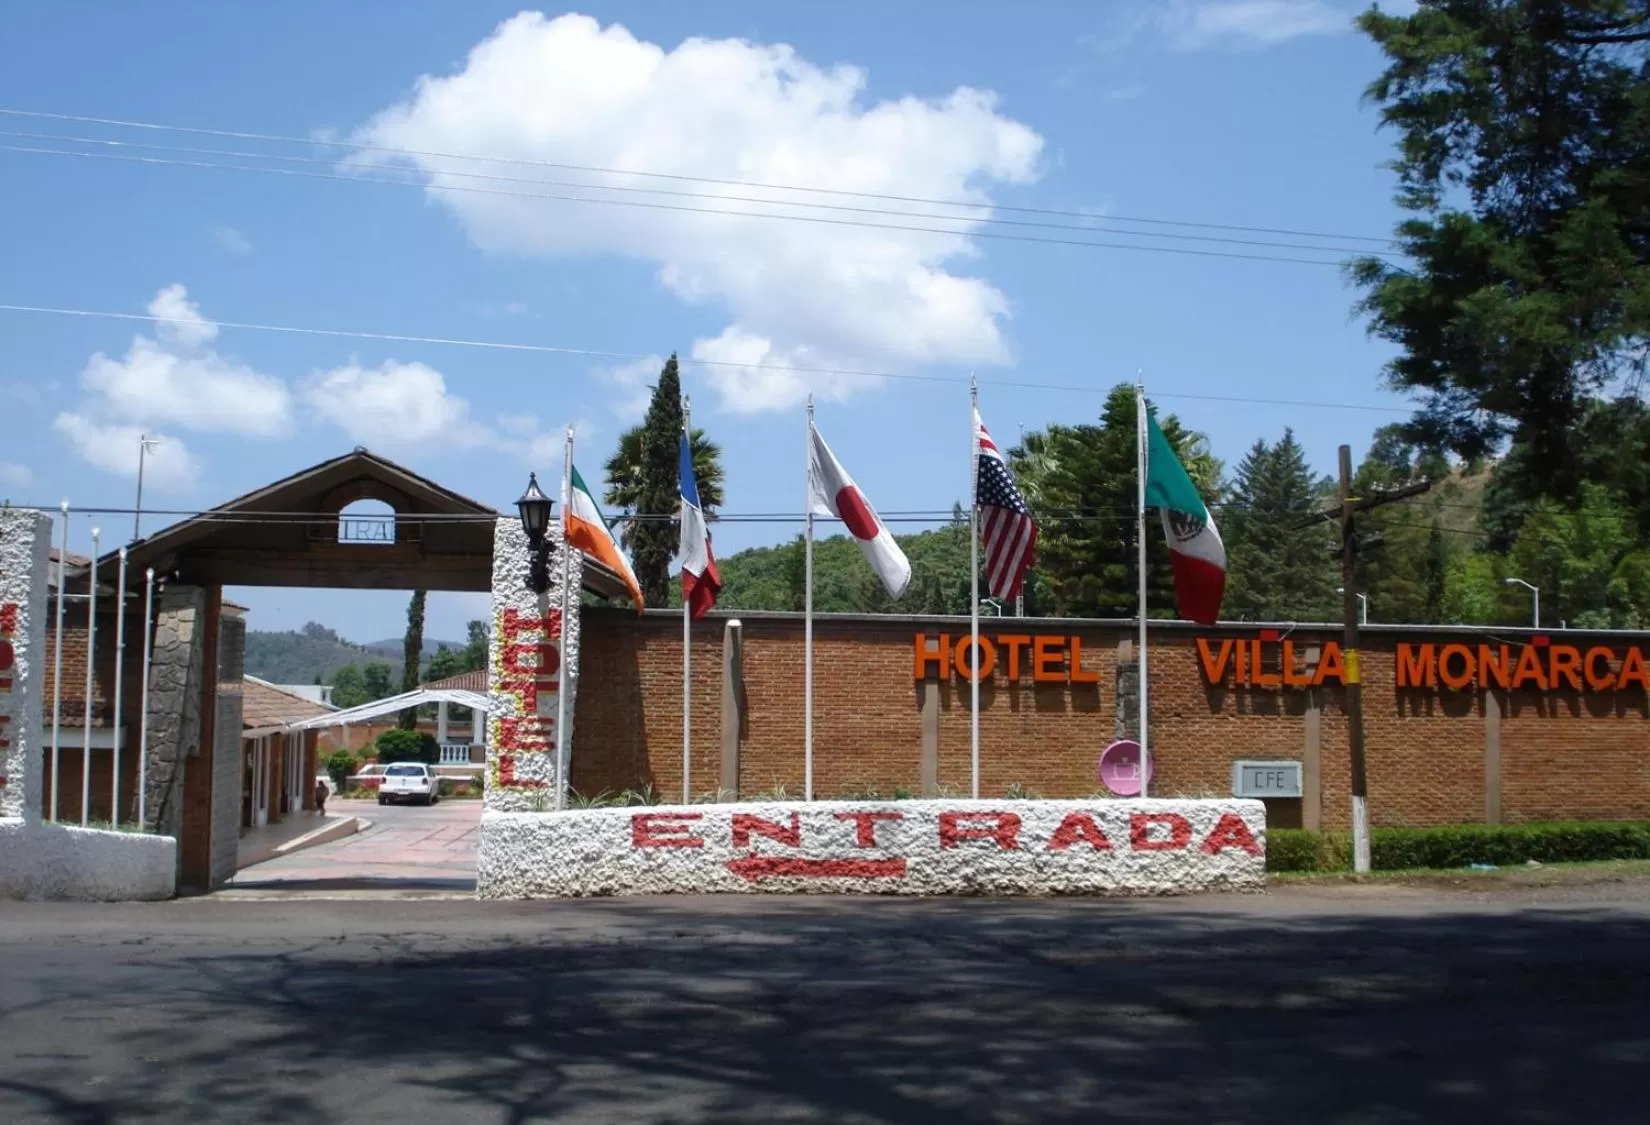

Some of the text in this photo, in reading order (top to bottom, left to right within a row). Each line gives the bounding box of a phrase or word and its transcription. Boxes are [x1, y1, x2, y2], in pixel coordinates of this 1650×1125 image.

[914, 633, 1650, 691] HOTEL VILLA MONARCA
[498, 607, 562, 787] HOTEL
[1255, 771, 1284, 788] CFE
[631, 811, 1263, 857] ENTRADA
